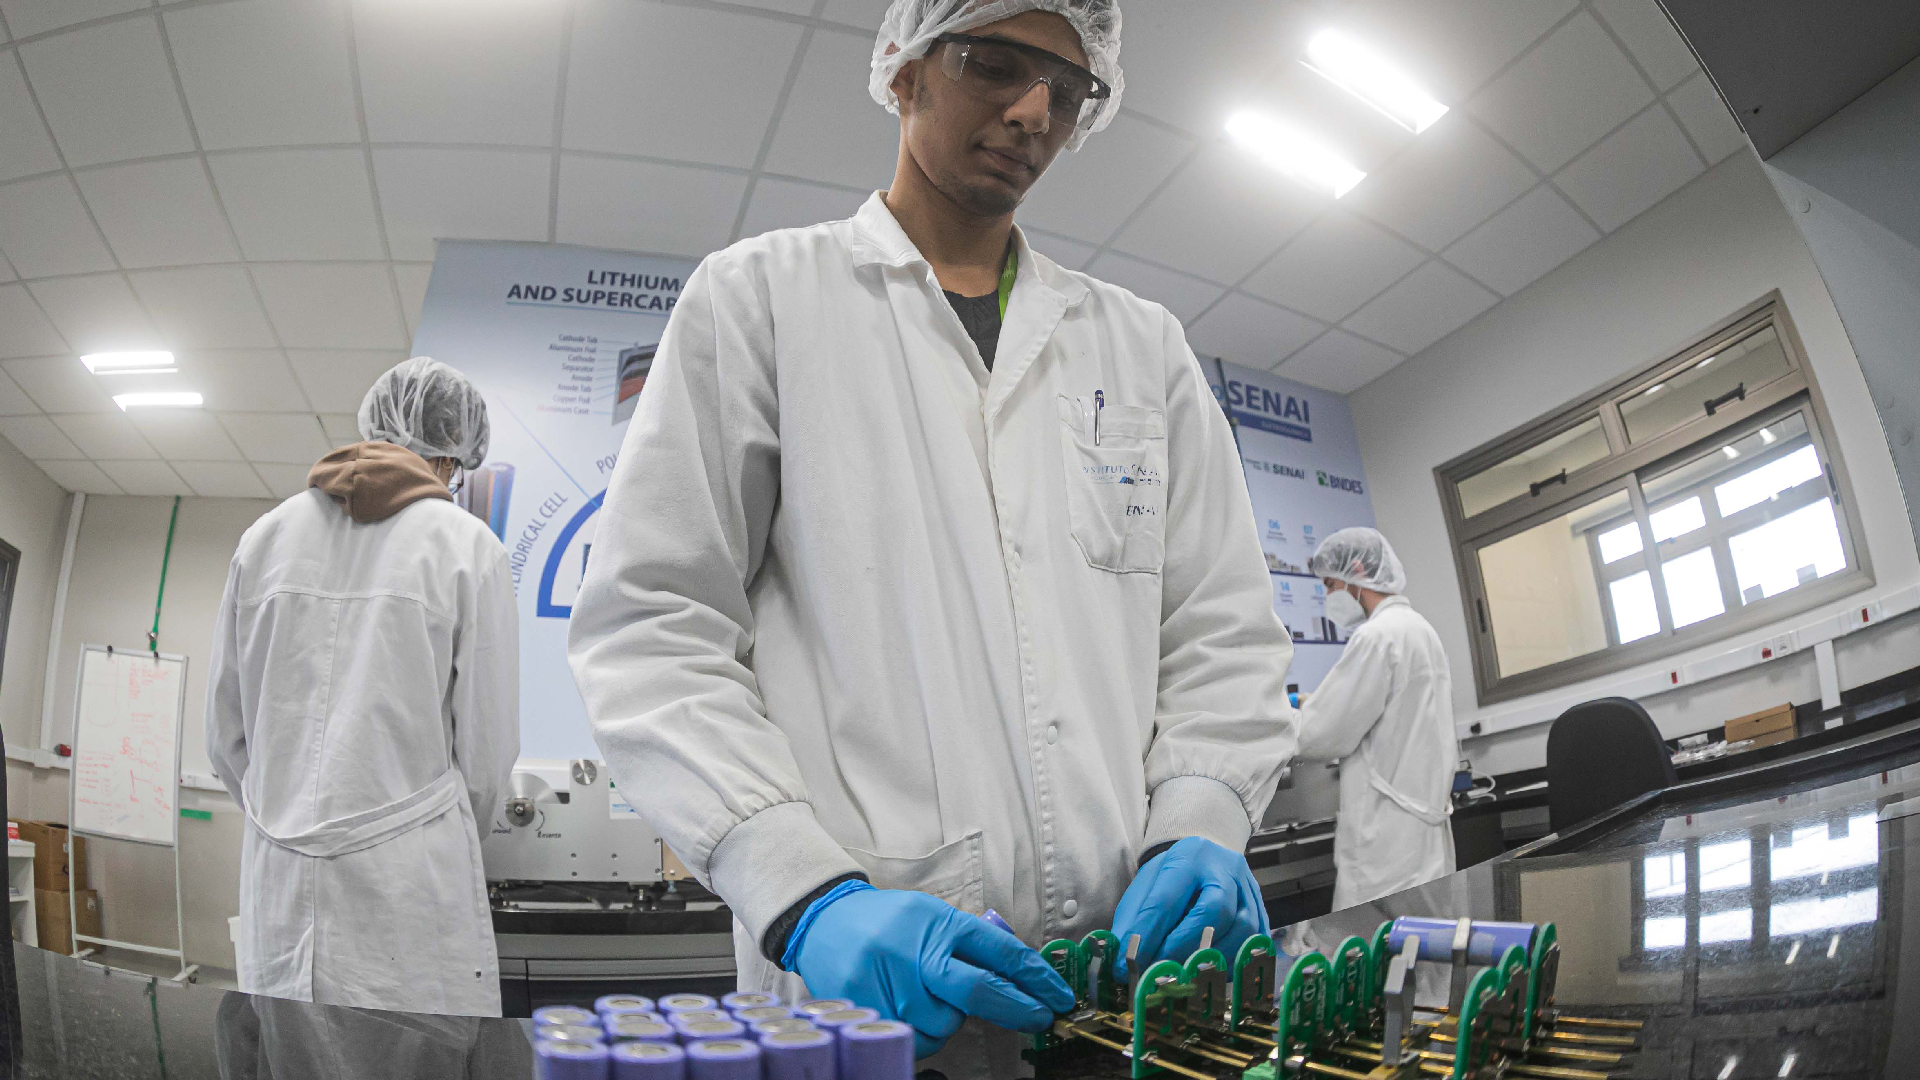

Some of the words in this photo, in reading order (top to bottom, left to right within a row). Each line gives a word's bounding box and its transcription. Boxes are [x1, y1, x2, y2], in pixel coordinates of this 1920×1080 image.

[507, 283, 557, 301] AND
[562, 287, 677, 312] SUPERCAP
[558, 333, 585, 342] Cathode
[586, 335, 598, 344] Tab
[567, 354, 595, 362] Cathode
[557, 383, 579, 391] Anode
[580, 384, 592, 393] Tab
[1228, 380, 1310, 424] SENAI
[1273, 463, 1305, 480] SENAI
[1329, 474, 1364, 495] BNDES
[539, 491, 569, 518] CELL
